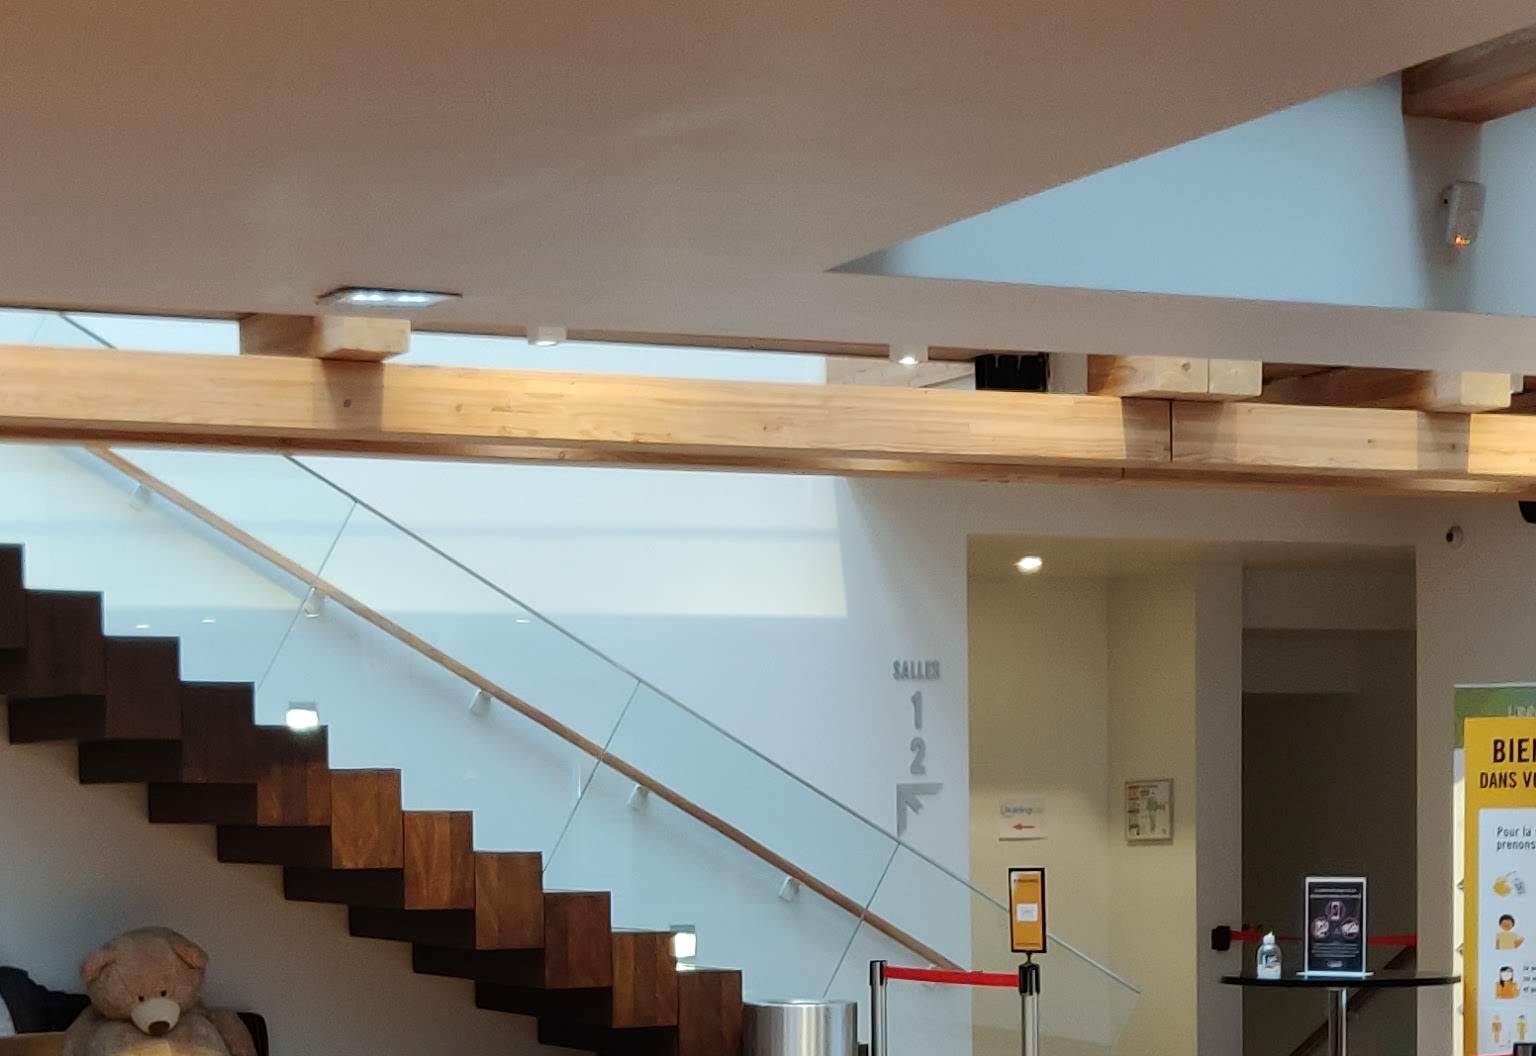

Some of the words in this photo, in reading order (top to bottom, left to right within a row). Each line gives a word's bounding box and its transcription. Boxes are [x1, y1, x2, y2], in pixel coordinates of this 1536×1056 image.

[892, 659, 941, 681] SALLES
[910, 690, 922, 731] 1
[909, 736, 927, 776] 2
[1479, 771, 1517, 789] DANS
[1496, 825, 1520, 837] Pour
[1522, 825, 1532, 837] la
[1496, 840, 1536, 851] prenons
